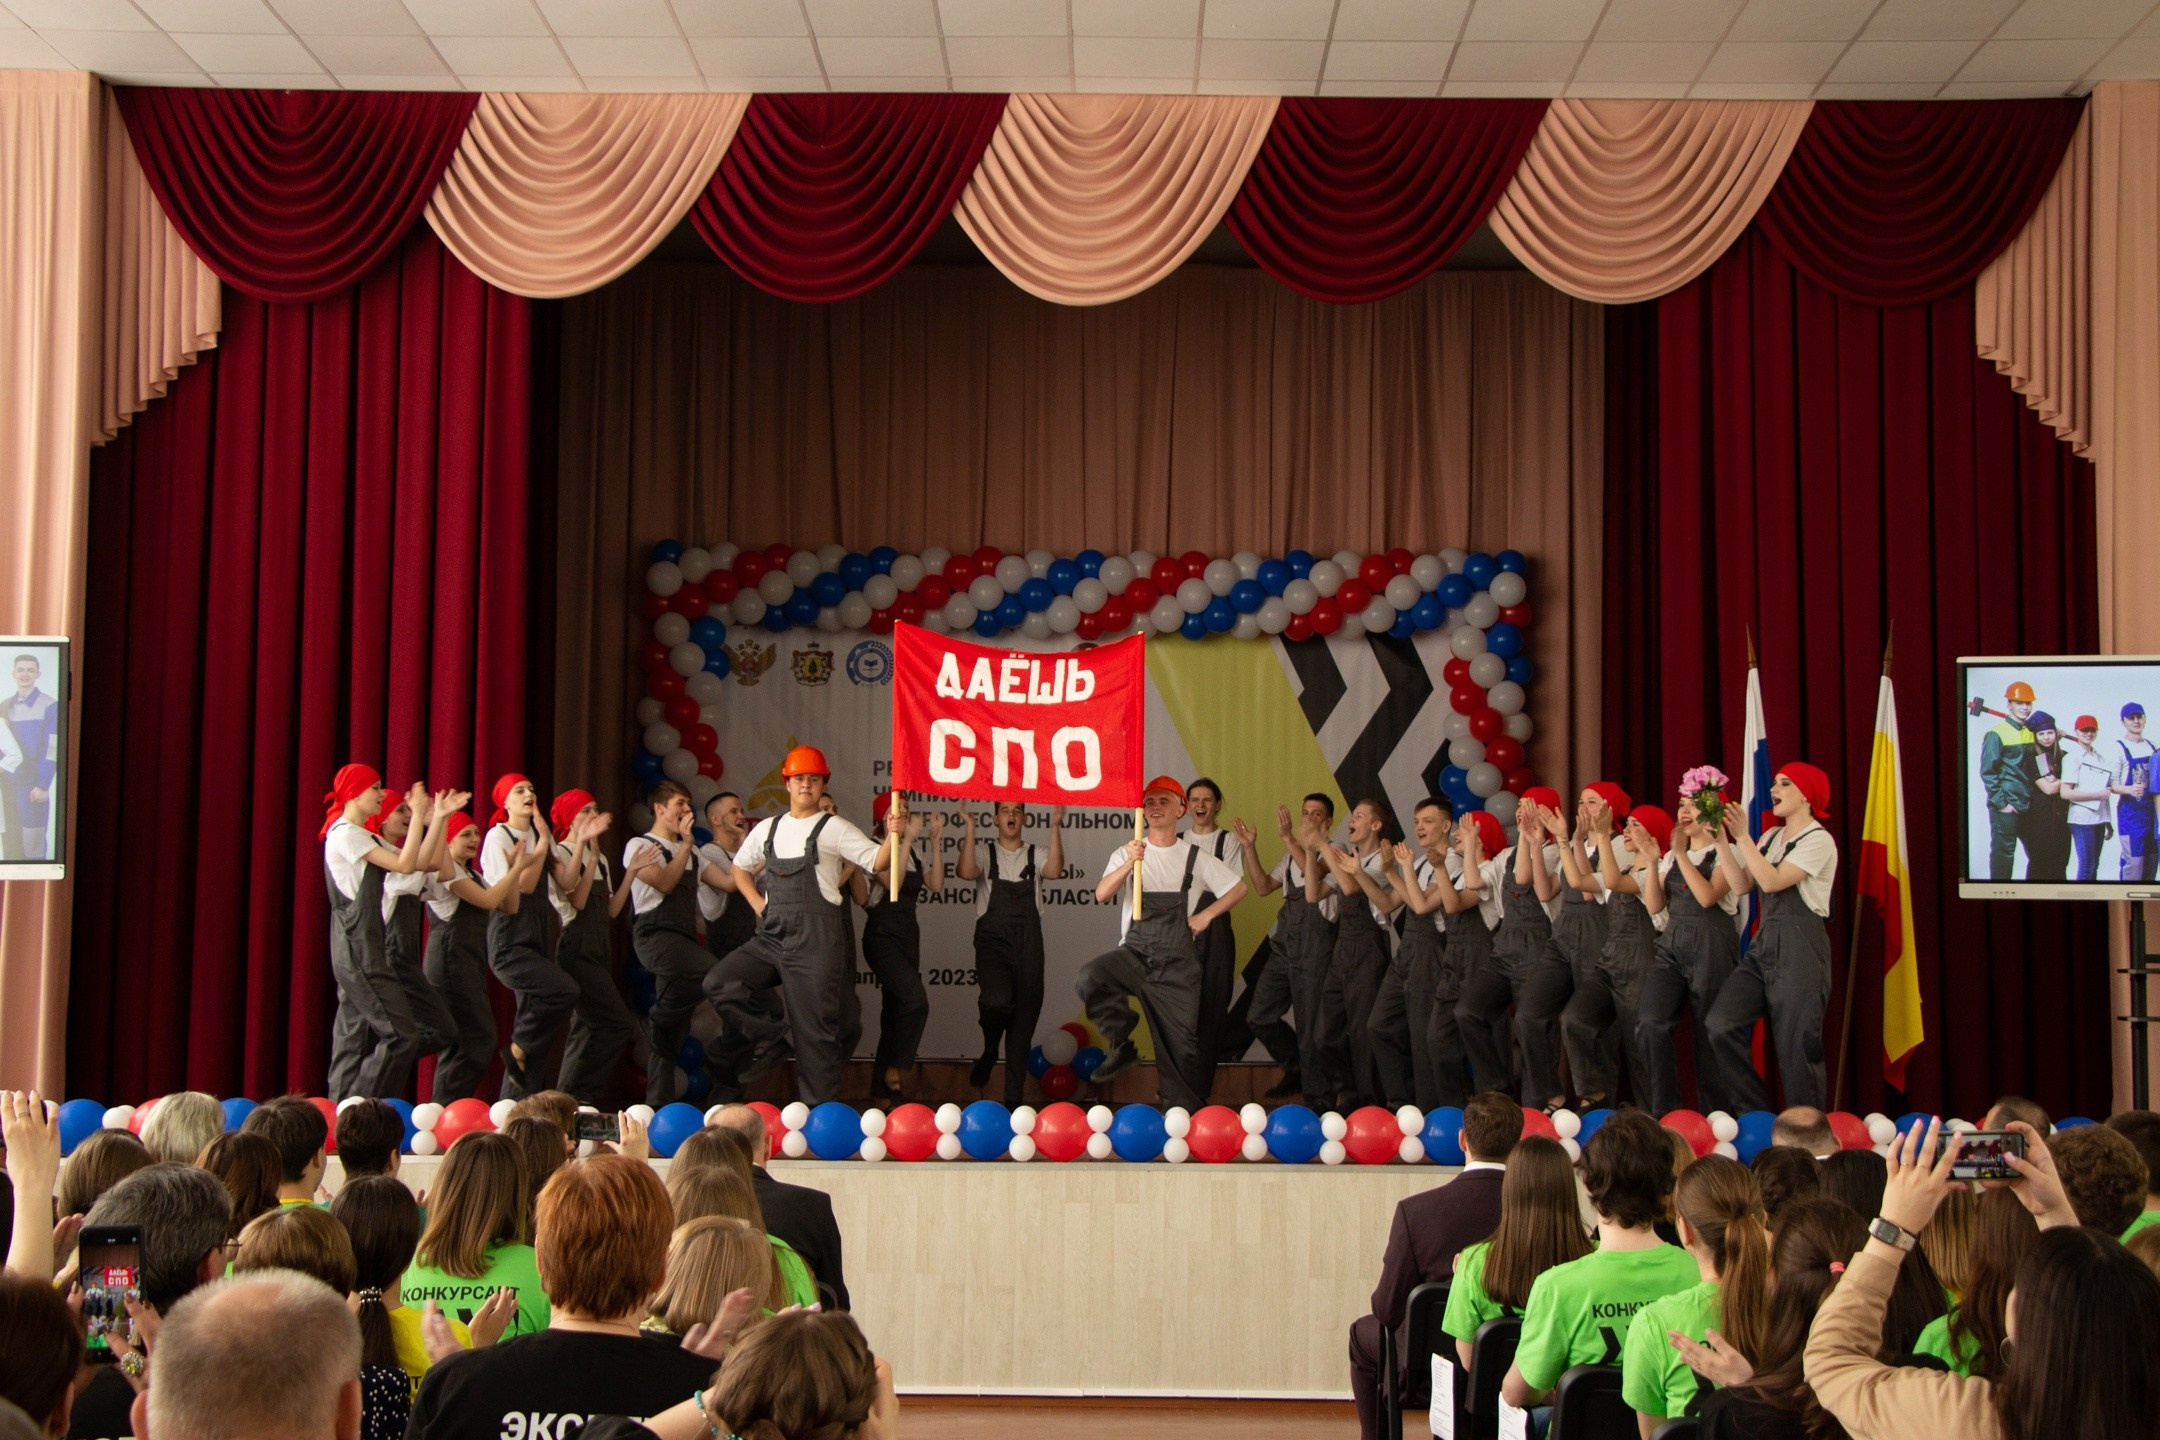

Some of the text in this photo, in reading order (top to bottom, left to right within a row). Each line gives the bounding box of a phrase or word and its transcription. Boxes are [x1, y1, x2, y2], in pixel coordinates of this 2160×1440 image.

[936, 652, 1095, 704] ДАЁШЬ
[929, 718, 1101, 791] СПО
[928, 968, 978, 986] 2023
